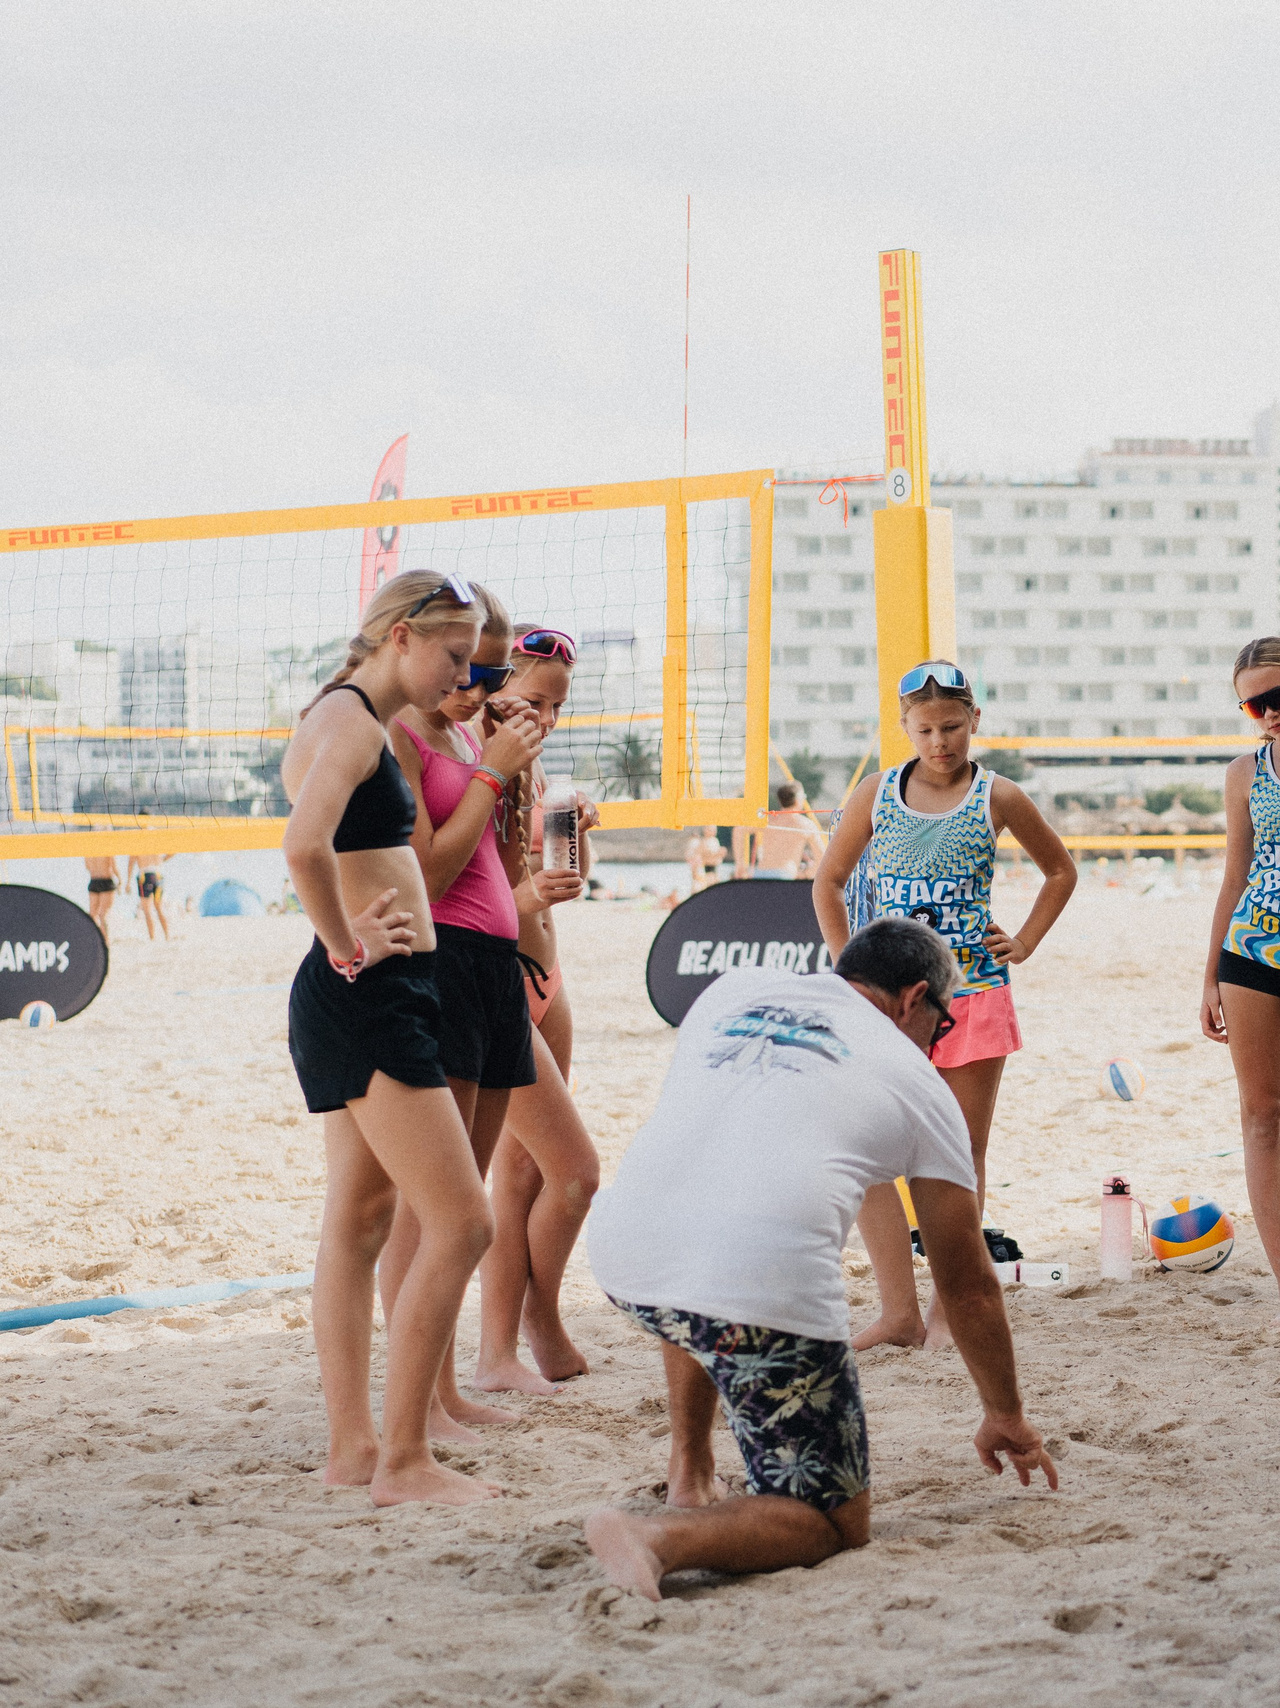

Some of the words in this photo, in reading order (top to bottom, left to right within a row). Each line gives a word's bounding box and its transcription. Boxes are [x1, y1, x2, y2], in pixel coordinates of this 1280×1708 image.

[883, 252, 906, 468] FUNTEC
[893, 475, 906, 497] 8
[451, 489, 593, 515] FUNTEC
[9, 523, 134, 546] FUNTEC
[880, 876, 974, 906] BEACH
[677, 940, 760, 975] BEACH
[762, 941, 815, 975] BOX
